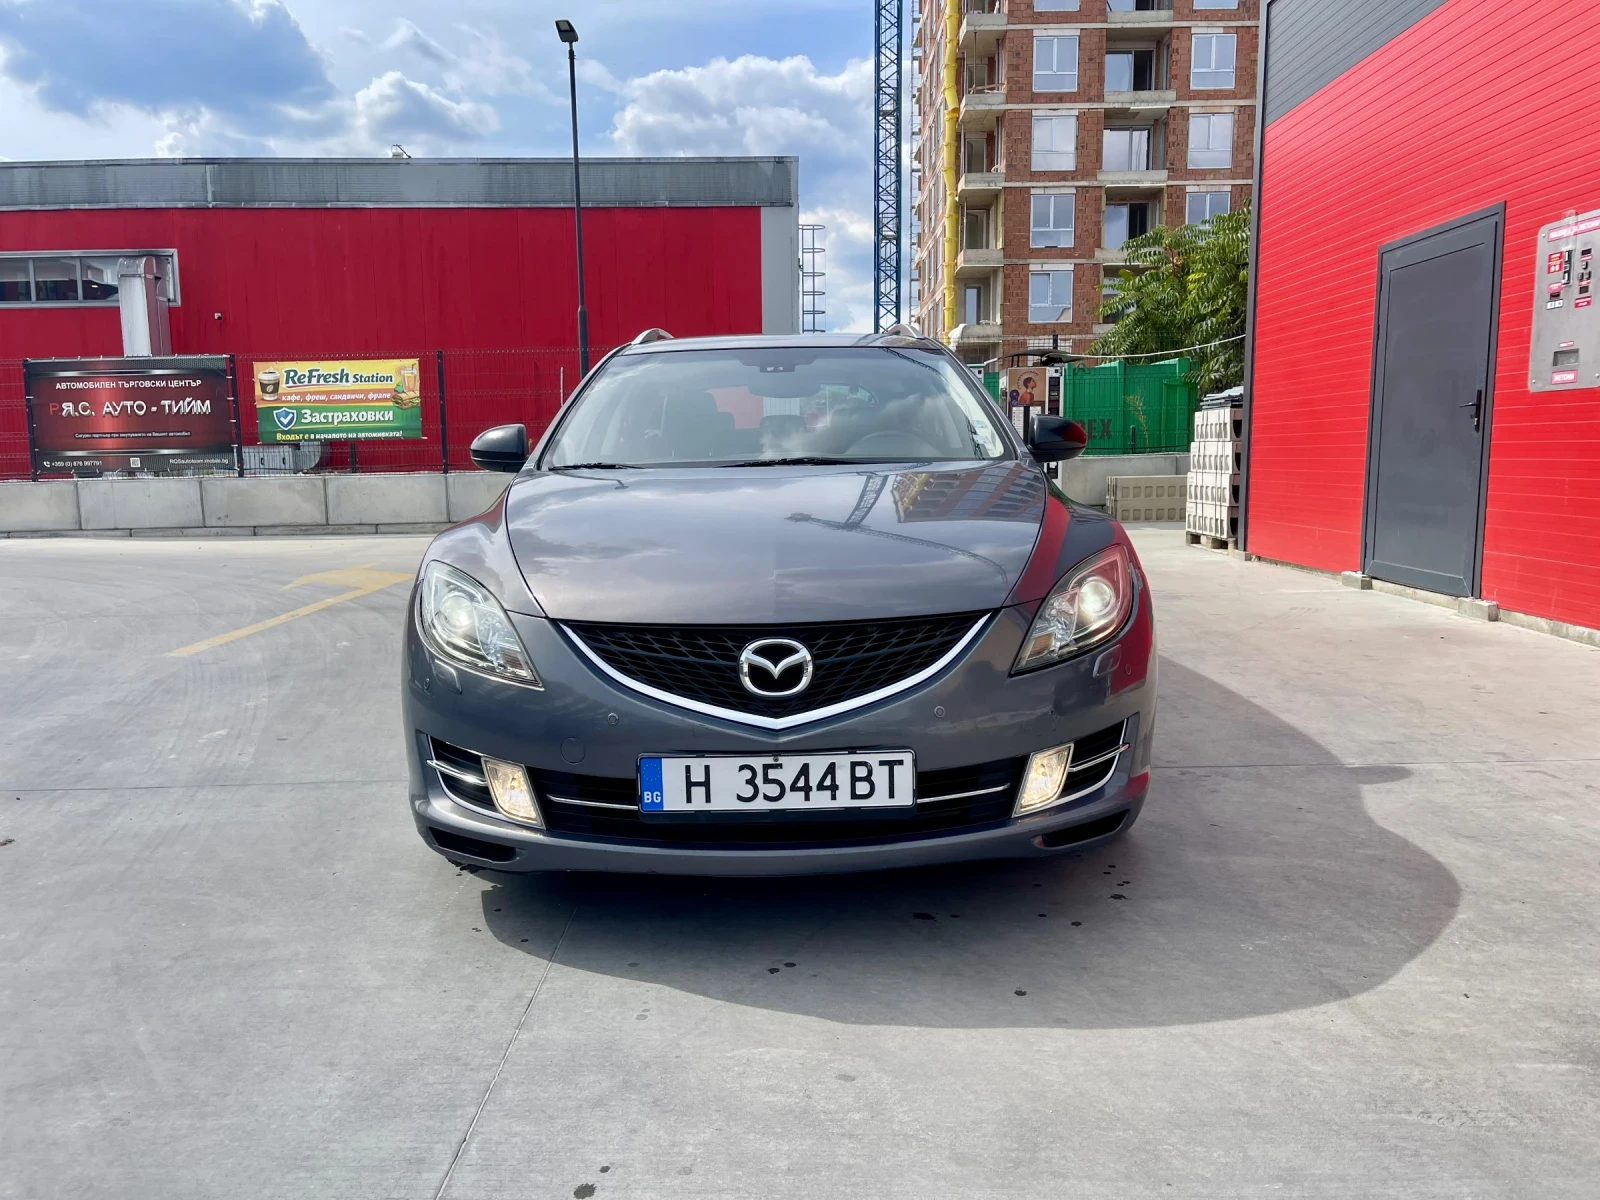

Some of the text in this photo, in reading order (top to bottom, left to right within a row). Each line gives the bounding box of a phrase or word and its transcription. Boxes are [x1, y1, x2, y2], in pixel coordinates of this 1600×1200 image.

[284, 368, 393, 385] ReFresh Station
[55, 379, 202, 390] АВТОМОБИЛЕН ТЪРГОВСКИ ЦЕНТЪР
[281, 392, 391, 402] кафе, фреш, сандвичи, фрапе
[102, 401, 147, 416] АУТО
[161, 397, 211, 415] ТИЙМ
[301, 410, 394, 425] Застраховки
[276, 432, 303, 441] Входът
[685, 764, 711, 804] H
[643, 791, 661, 803] BG
